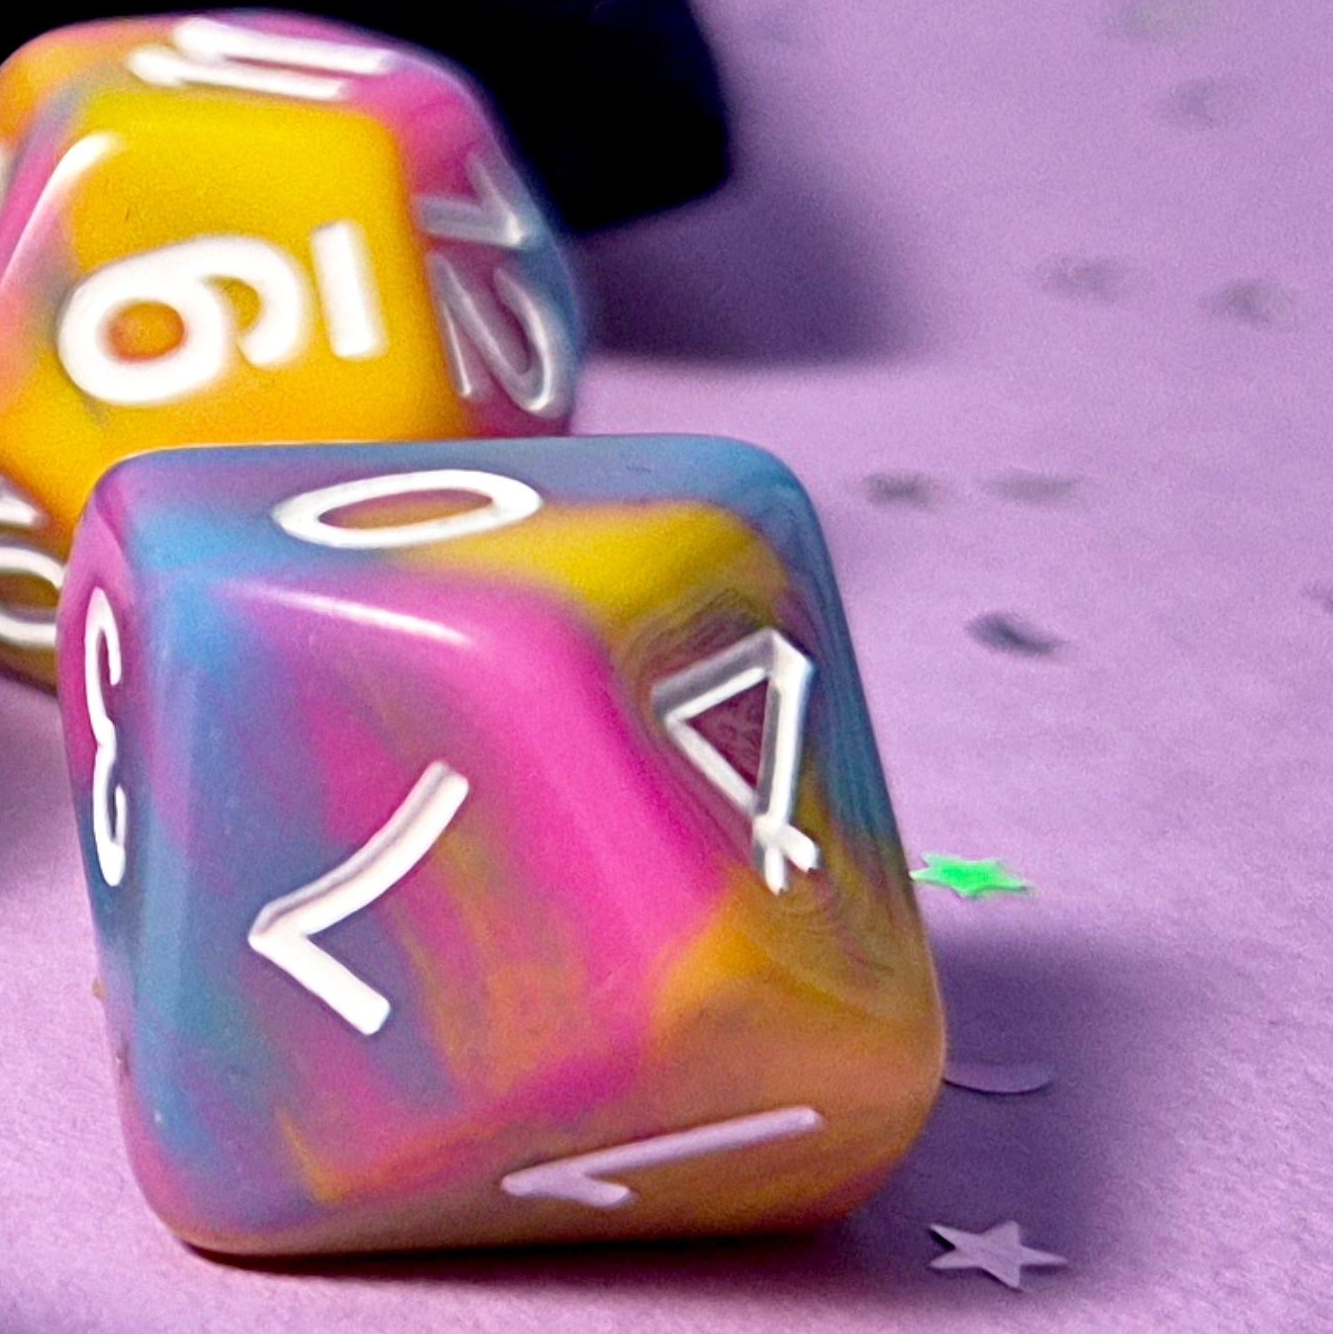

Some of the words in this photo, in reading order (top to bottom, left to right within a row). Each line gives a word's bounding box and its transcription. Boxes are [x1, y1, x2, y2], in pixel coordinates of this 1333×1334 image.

[270, 469, 545, 551] 0
[83, 585, 127, 887] 3
[651, 627, 821, 895] 4
[248, 760, 471, 1037] 7
[499, 1105, 825, 1209] 1
